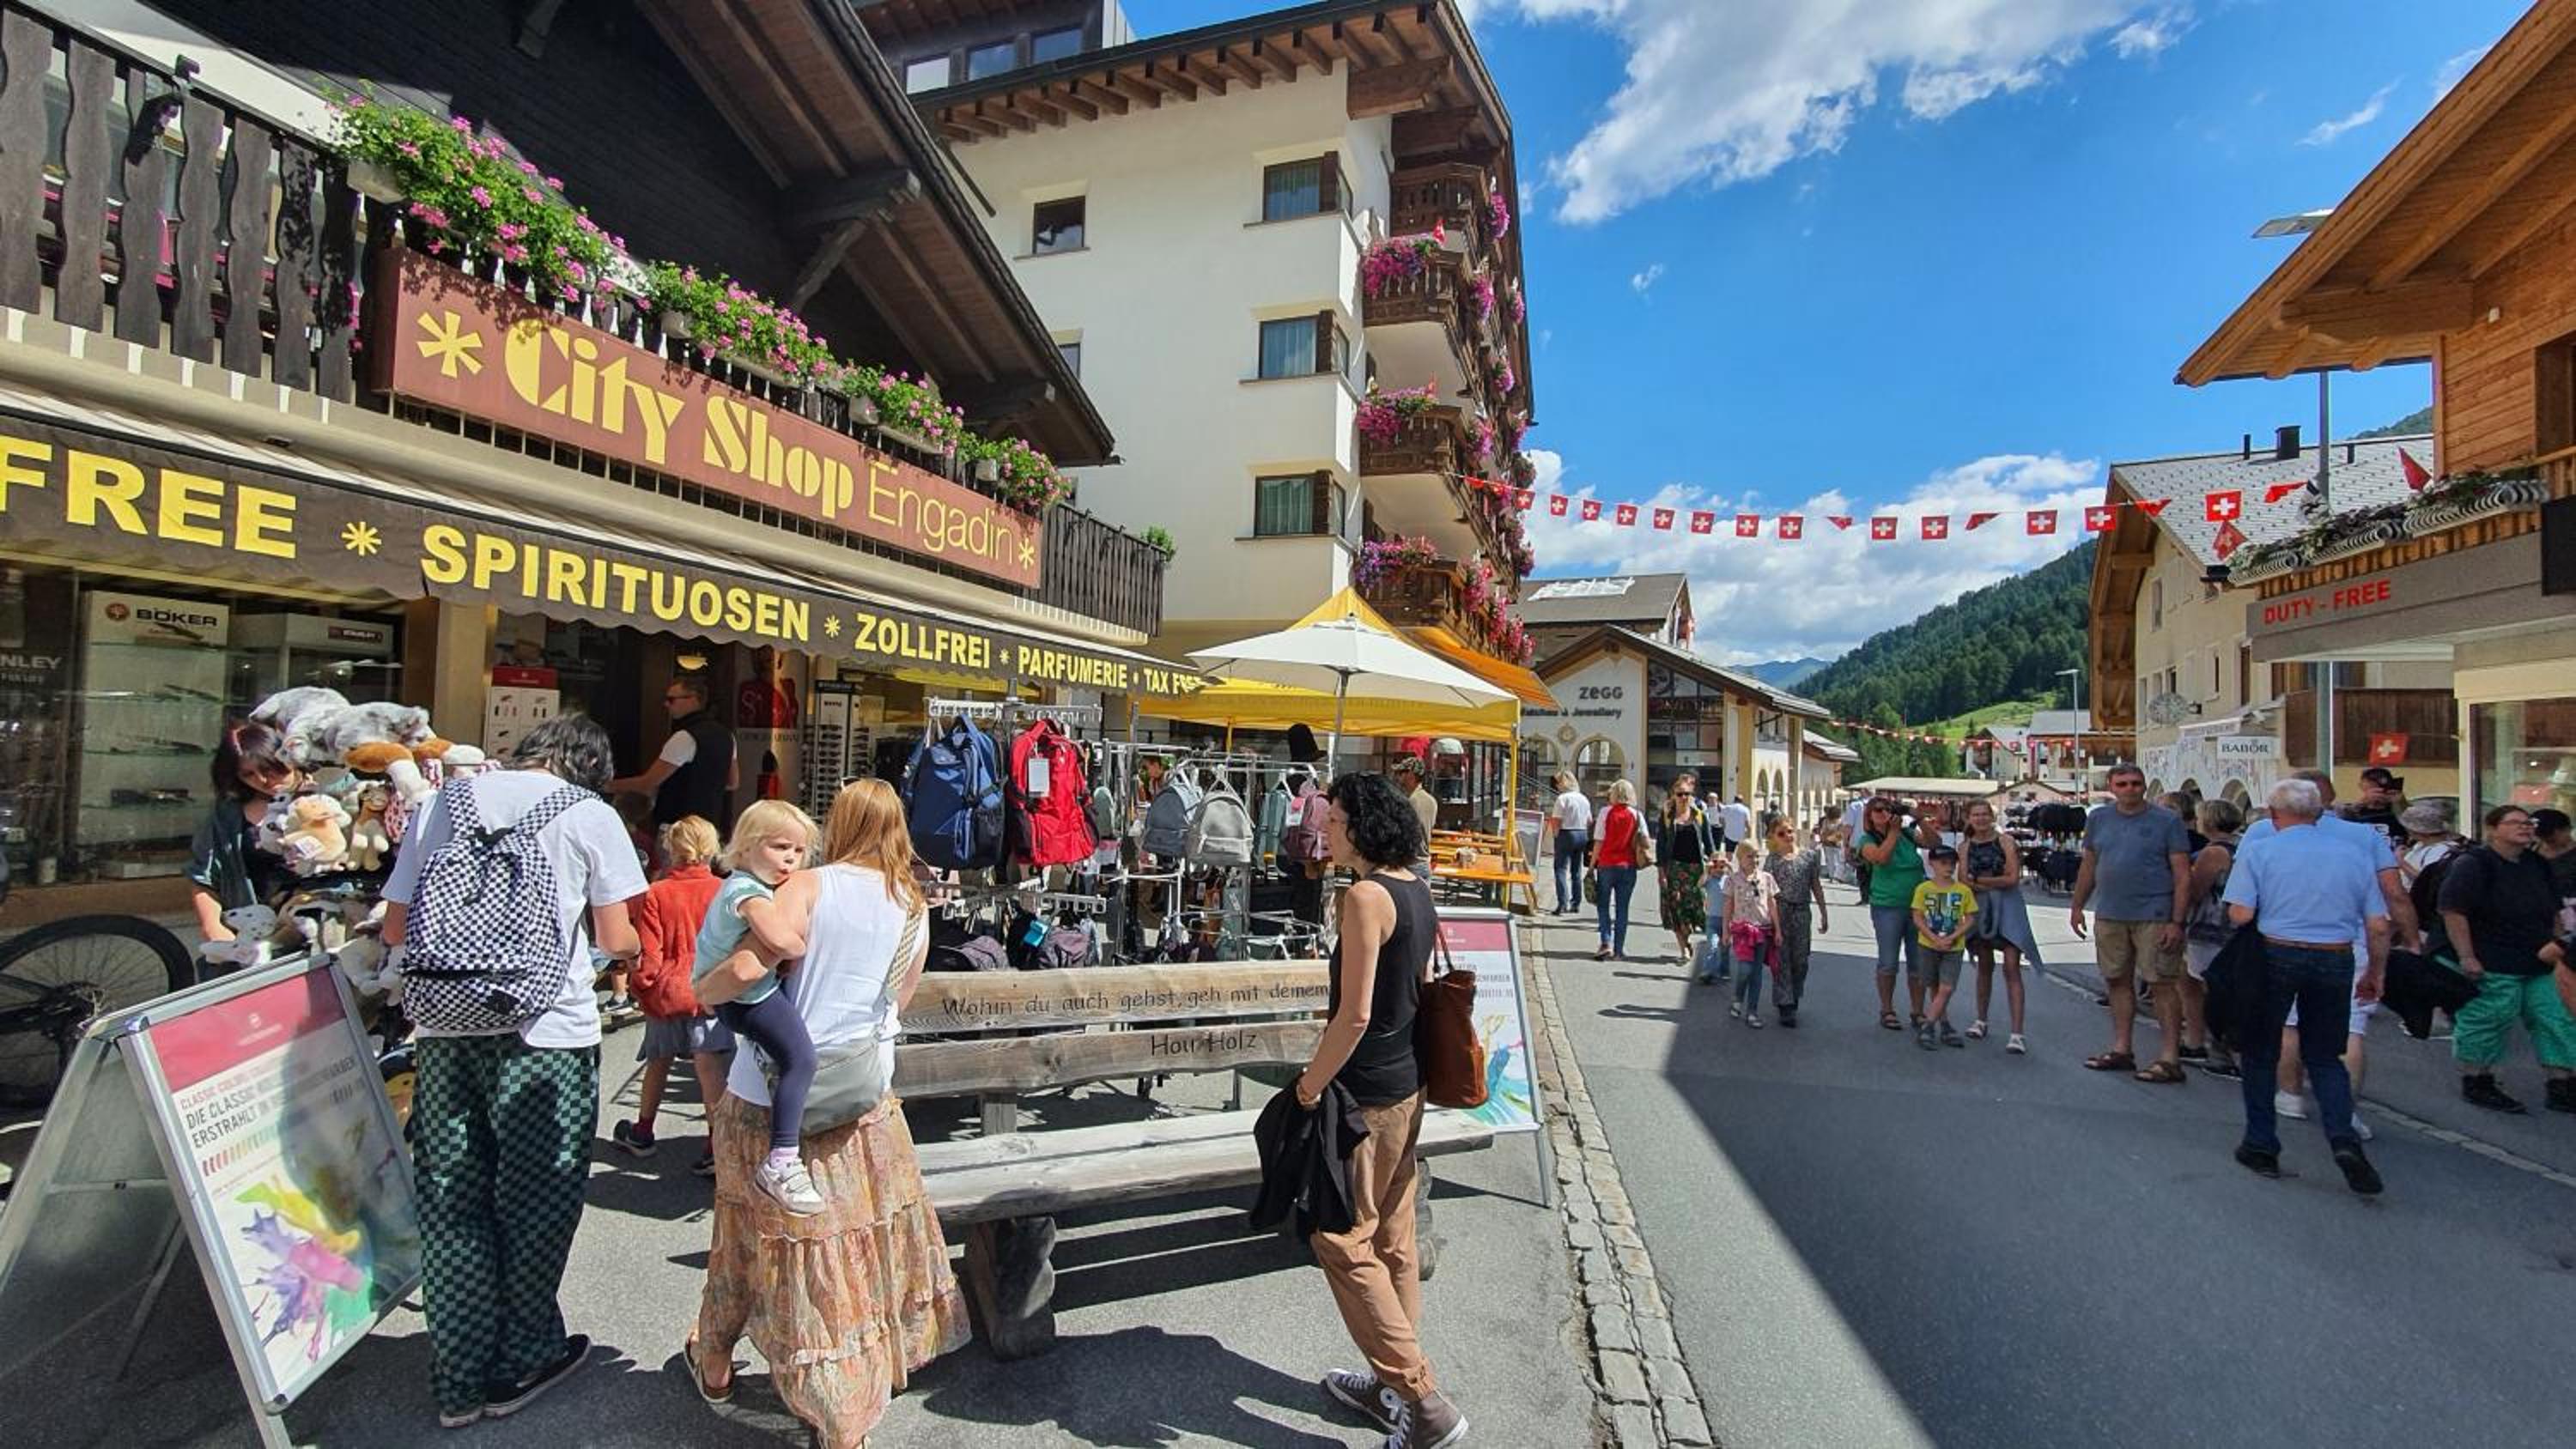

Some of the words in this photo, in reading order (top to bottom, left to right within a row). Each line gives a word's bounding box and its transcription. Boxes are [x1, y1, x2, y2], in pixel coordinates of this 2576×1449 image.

[504, 318, 684, 465] City
[703, 395, 854, 518] Shop
[867, 460, 1012, 565] Engadin
[0, 435, 296, 559] FREE
[420, 524, 809, 641] SPIRITUOSEN
[854, 613, 990, 668] ZOLLFREI
[1018, 646, 1127, 688] PARFUMERIE
[1144, 668, 1168, 694] TAX
[2263, 597, 2316, 624] DUTY
[2332, 579, 2391, 609] FREE
[2221, 743, 2269, 754] BABOR
[942, 996, 1012, 1016] Wohin
[1024, 994, 1049, 1014] du
[1062, 991, 1109, 1010] auch
[1188, 986, 1221, 1008] geh
[1230, 985, 1260, 1003] mit
[185, 1106, 208, 1130] DIE
